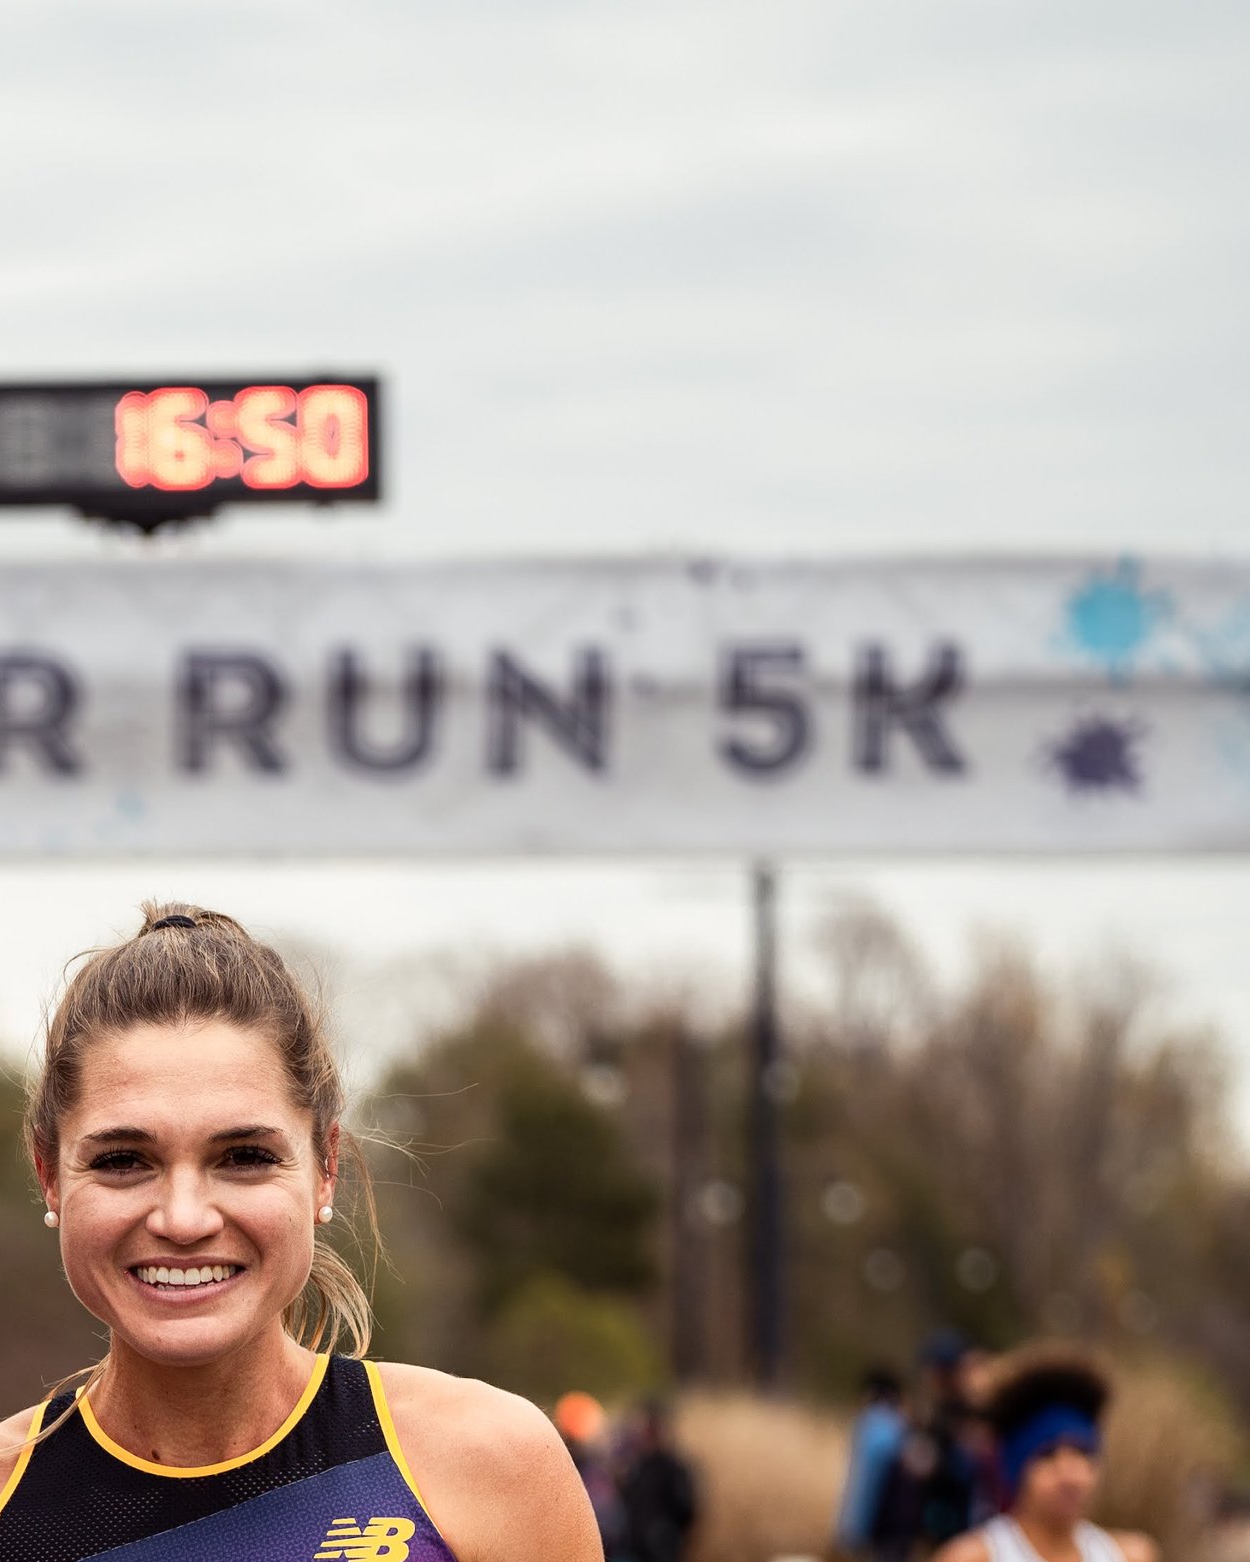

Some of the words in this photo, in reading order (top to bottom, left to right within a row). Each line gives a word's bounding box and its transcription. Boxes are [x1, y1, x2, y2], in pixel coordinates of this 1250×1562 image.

[115, 385, 368, 491] 16:50
[174, 646, 612, 778] RUN
[716, 644, 970, 780] 5K
